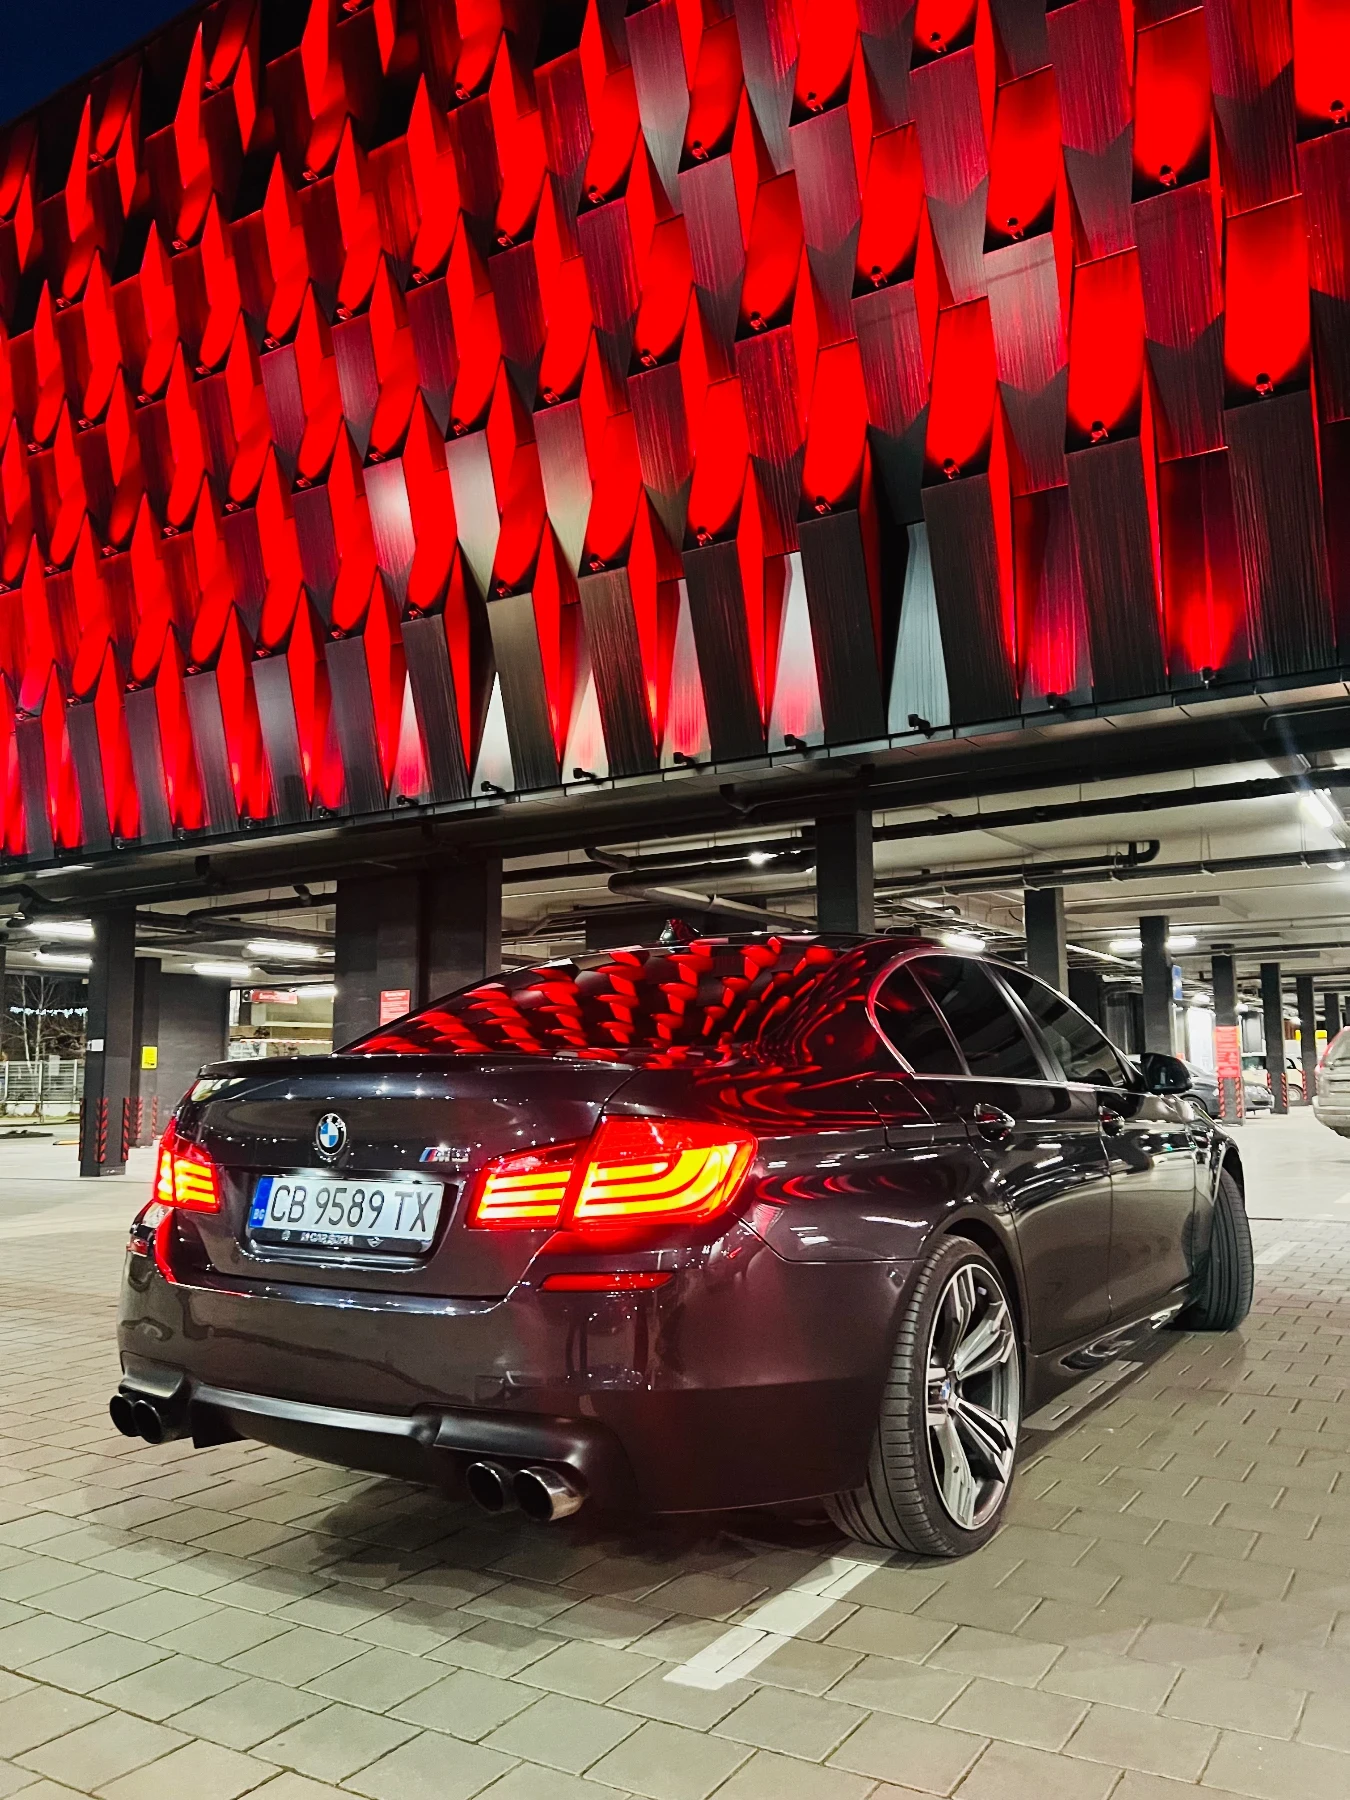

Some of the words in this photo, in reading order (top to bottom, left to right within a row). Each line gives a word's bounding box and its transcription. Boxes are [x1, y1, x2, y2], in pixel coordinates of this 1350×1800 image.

[252, 1208, 266, 1220] BG
[270, 1184, 307, 1223] CB
[314, 1187, 385, 1229] 9589
[394, 1190, 434, 1232] TX
